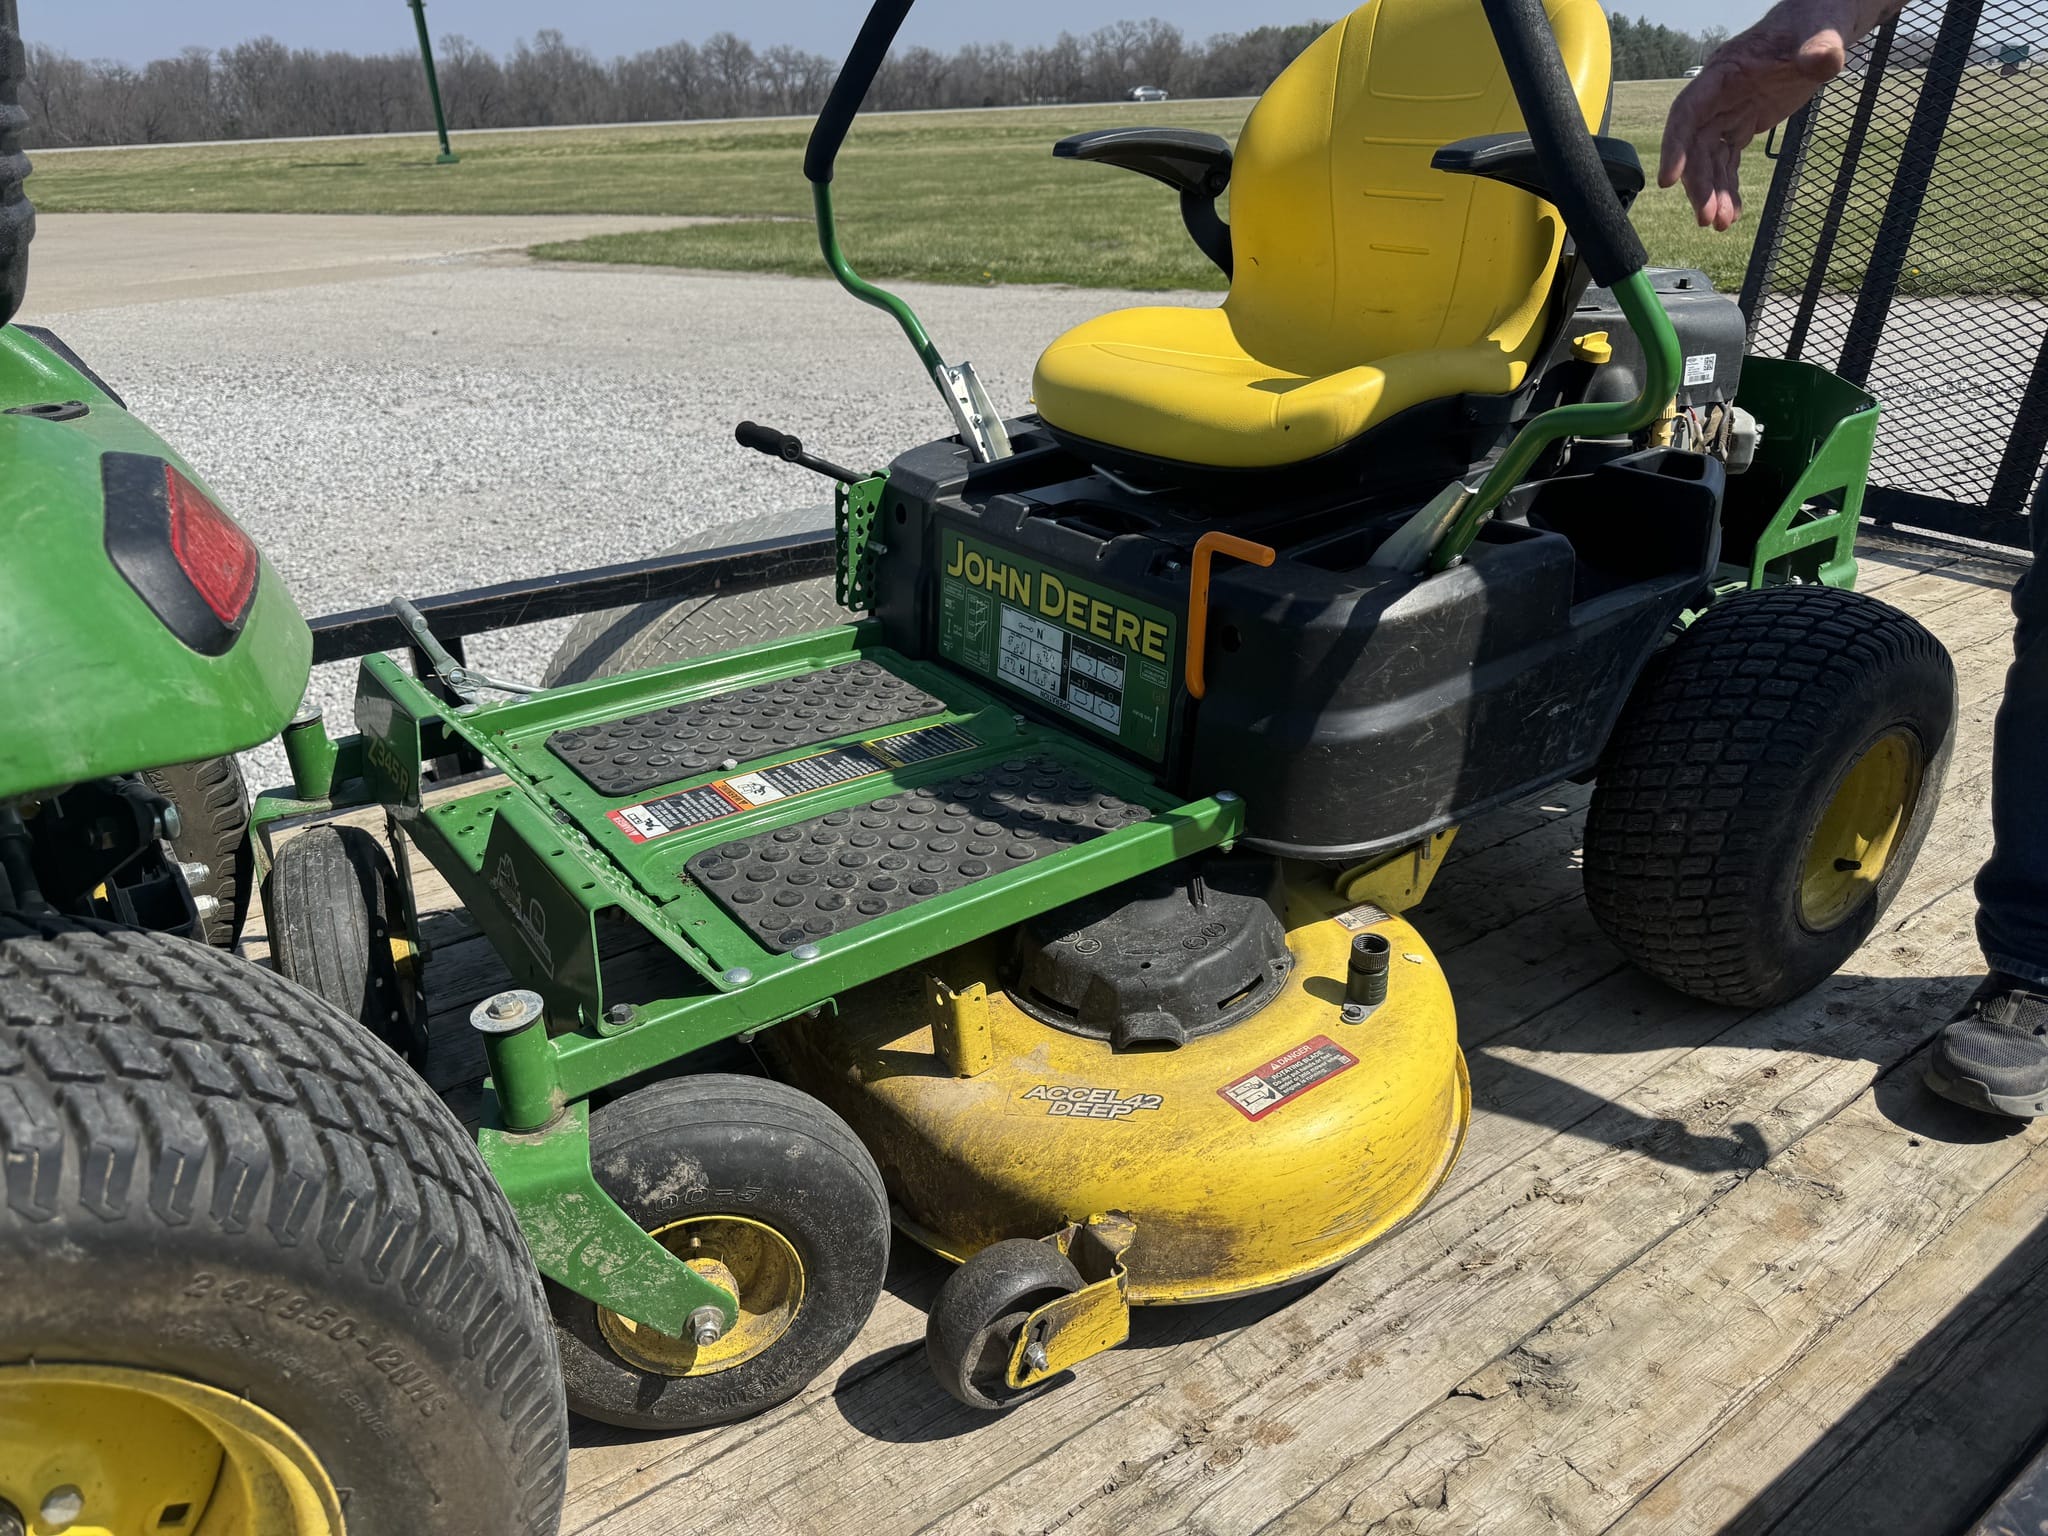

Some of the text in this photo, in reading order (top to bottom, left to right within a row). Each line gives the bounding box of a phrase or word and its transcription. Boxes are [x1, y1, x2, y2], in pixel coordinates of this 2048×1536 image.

[947, 540, 1168, 663] JOHN DEERE
[1036, 628, 1044, 640] N
[1019, 664, 1025, 675] R
[1050, 680, 1056, 691] F
[1039, 689, 1071, 711] OPERATION
[367, 735, 409, 796] Z345R
[1272, 1050, 1324, 1080] ROTATING BLADE
[1277, 1045, 1311, 1065] DANGER
[1278, 1080, 1294, 1090] under
[1299, 1070, 1310, 1078] into
[1290, 1070, 1301, 1078] put
[1020, 1085, 1164, 1110] ACCEL 42
[1282, 1082, 1301, 1093] engine
[1047, 1101, 1133, 1118] DEEP
[338, 1388, 394, 1441] SERVICE
